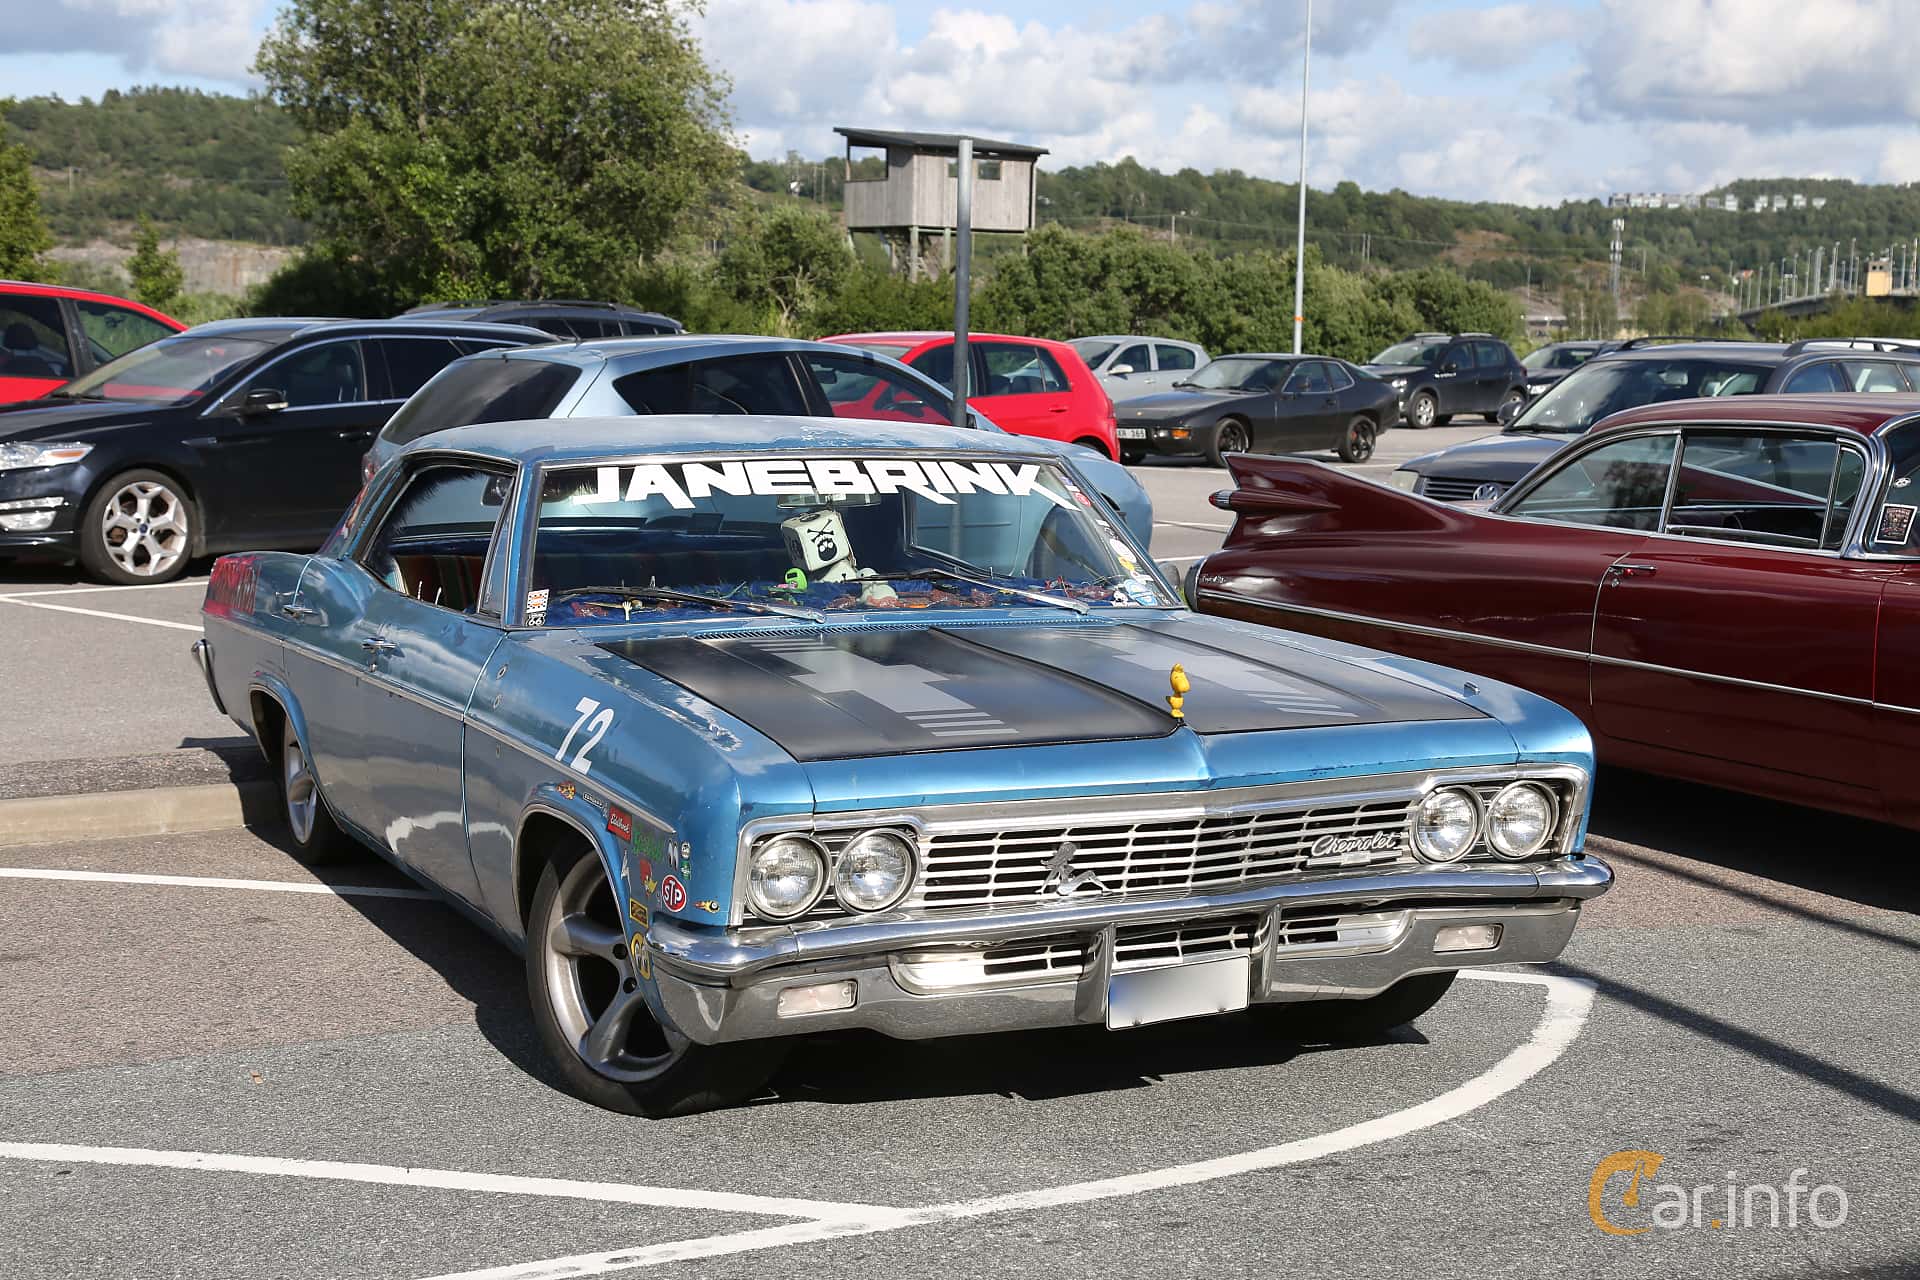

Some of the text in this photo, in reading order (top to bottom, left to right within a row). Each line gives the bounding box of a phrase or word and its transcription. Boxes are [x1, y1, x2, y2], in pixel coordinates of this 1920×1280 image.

[573, 459, 1081, 510] JANEBRINK
[555, 697, 615, 775] 72
[1311, 830, 1396, 857] Chevrolet
[663, 880, 683, 906] STP
